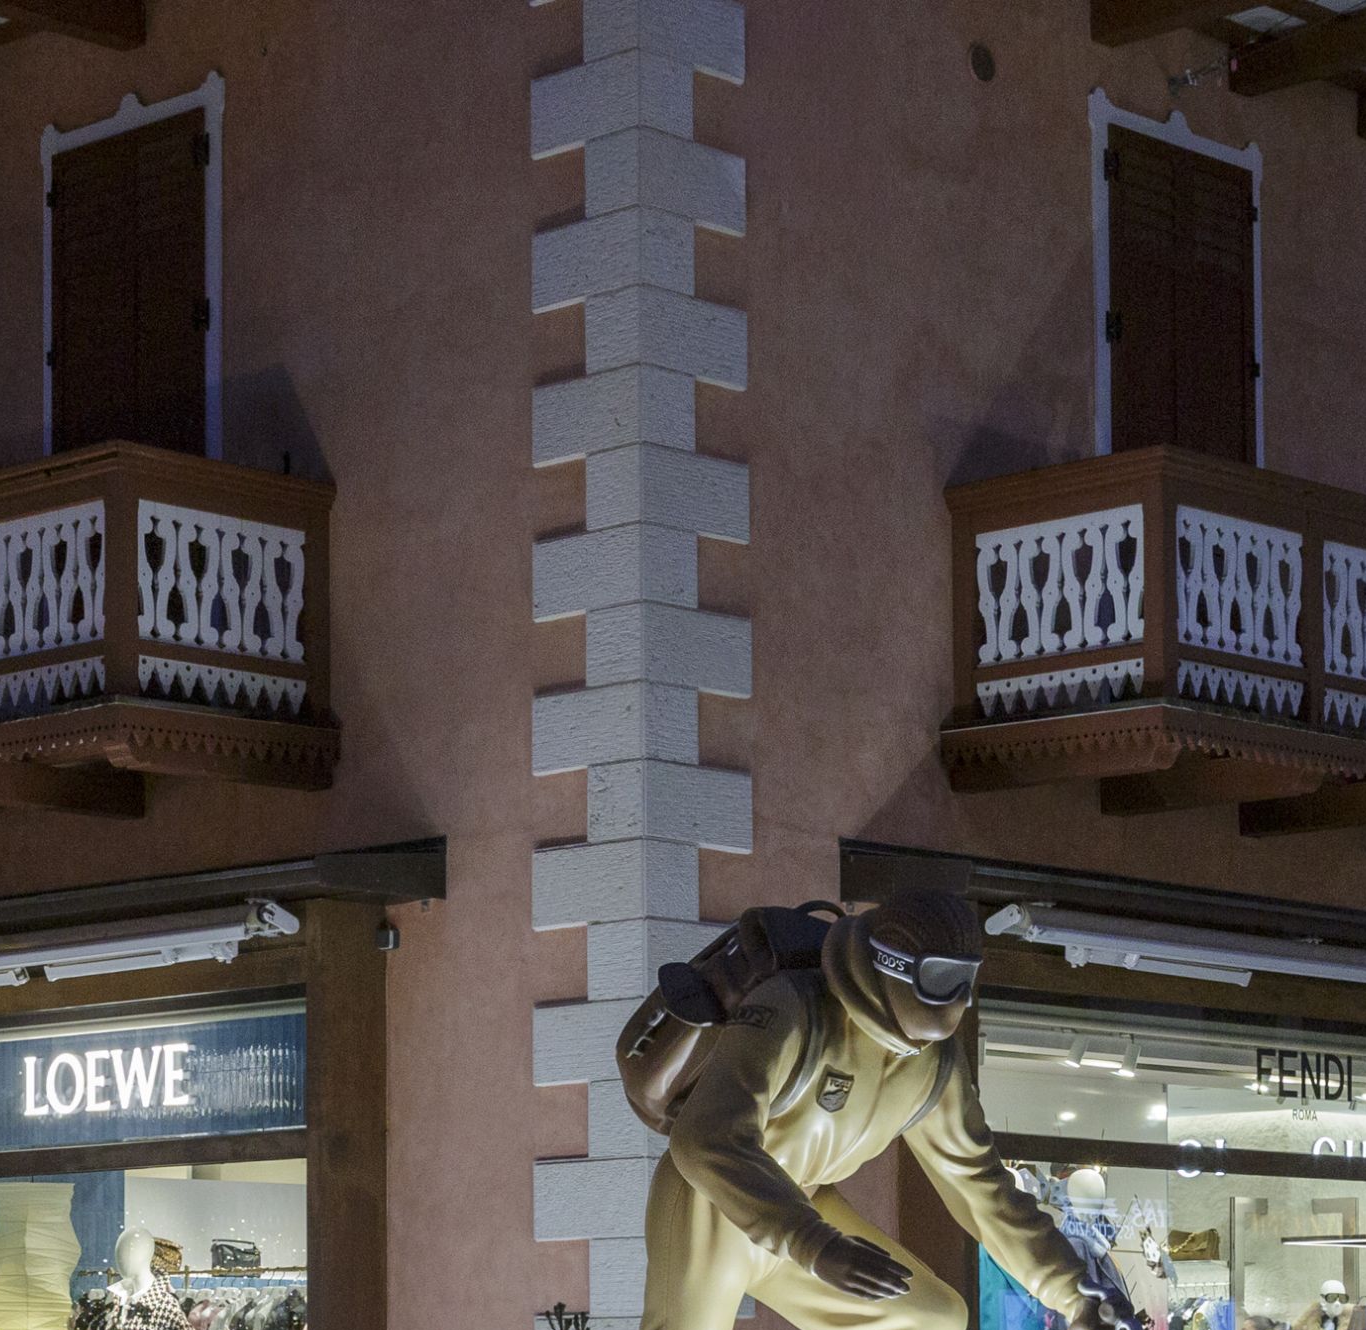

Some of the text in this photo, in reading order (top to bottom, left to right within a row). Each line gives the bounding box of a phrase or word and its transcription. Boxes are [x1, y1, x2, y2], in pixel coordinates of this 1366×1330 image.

[877, 951, 906, 971] TOD'S
[24, 1043, 190, 1116] LOEWE
[1256, 1048, 1353, 1102] FENDI
[1292, 1108, 1318, 1122] ROMA
